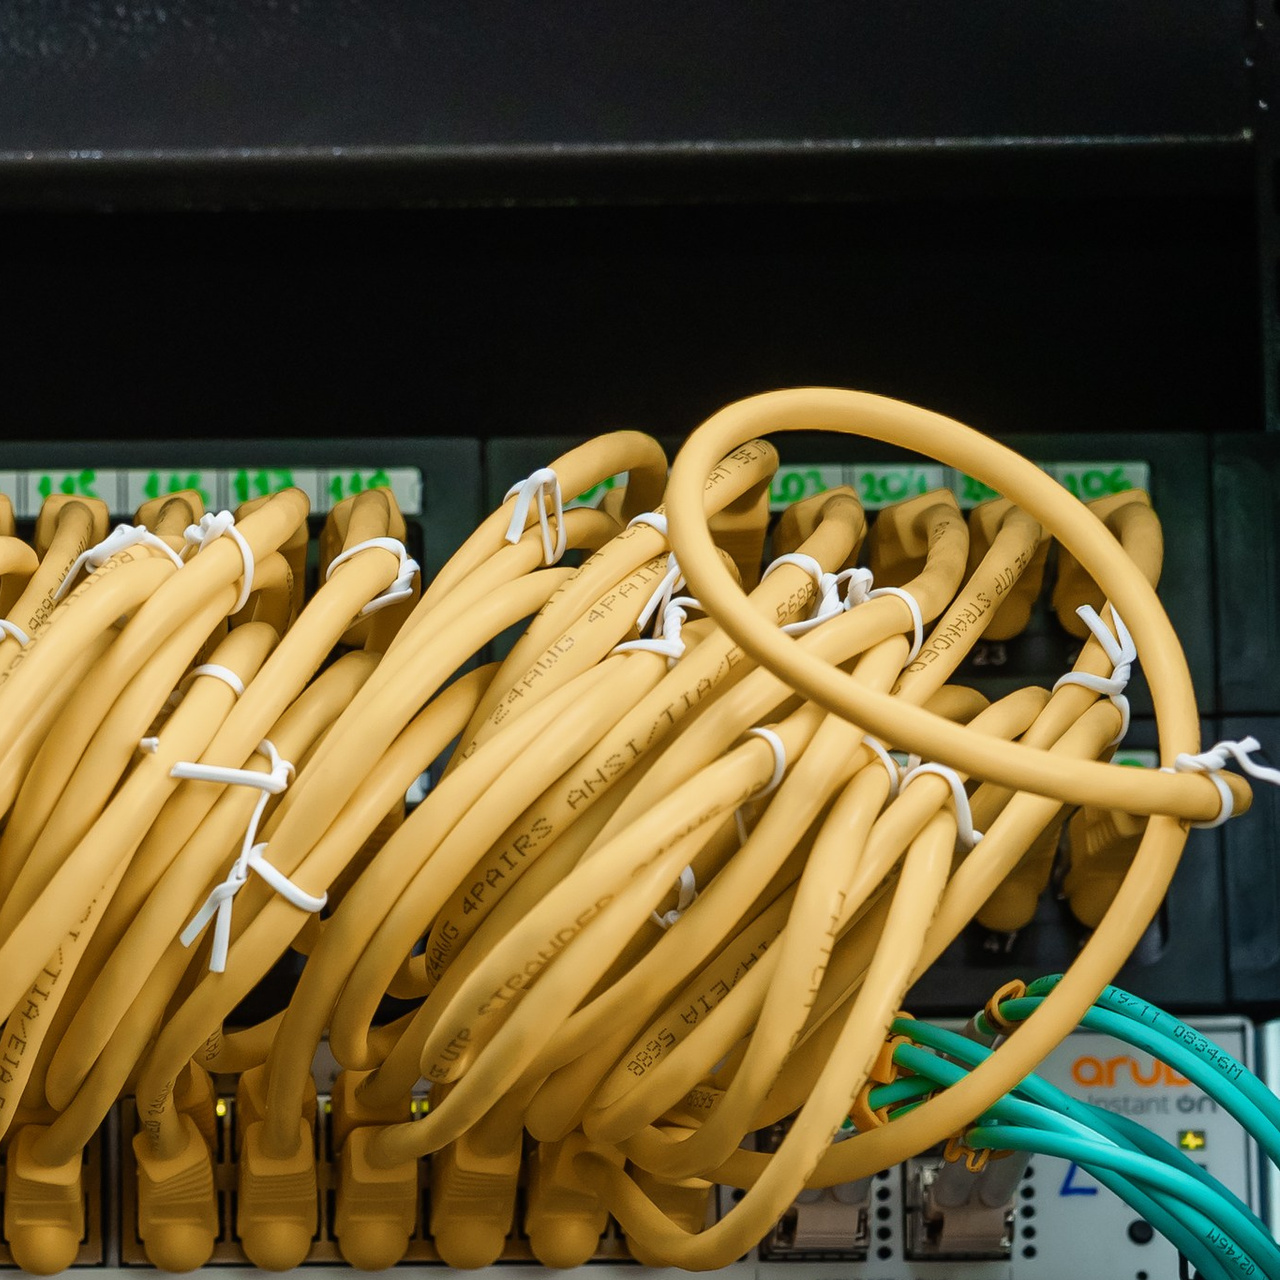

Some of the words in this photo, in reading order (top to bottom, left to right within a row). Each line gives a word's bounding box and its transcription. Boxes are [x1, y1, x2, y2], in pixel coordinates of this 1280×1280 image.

[908, 592, 992, 673] STRANDED
[462, 816, 553, 916] 4PAIRS
[627, 1027, 677, 1078] 568B
[1173, 1024, 1244, 1081] 08346M
